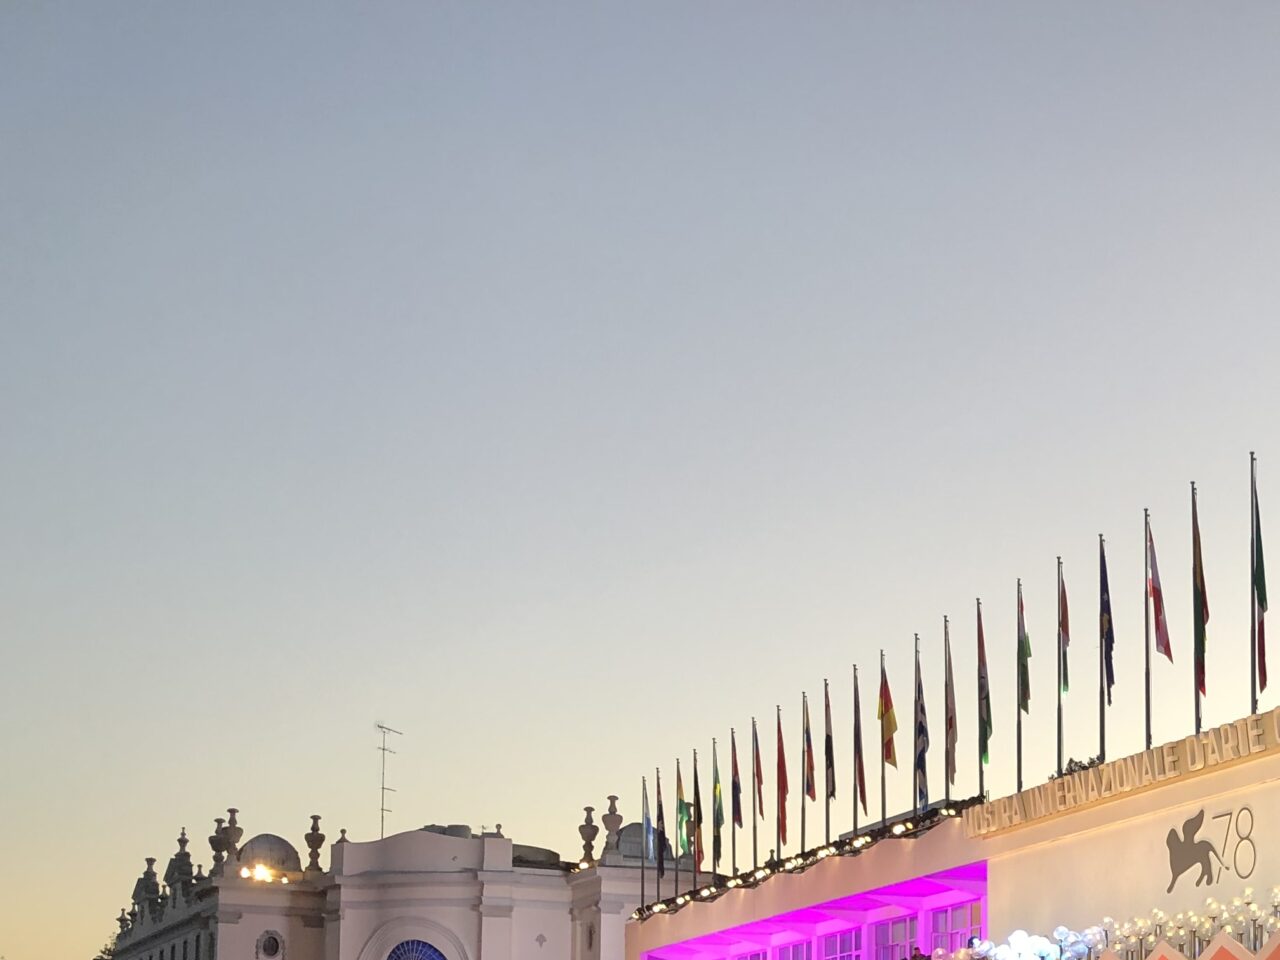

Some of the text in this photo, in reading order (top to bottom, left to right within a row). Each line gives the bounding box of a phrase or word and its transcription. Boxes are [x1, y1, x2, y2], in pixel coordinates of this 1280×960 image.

[962, 796, 1022, 838] MOSTRA
[1029, 742, 1181, 819] INTERNAZIONALE
[1185, 713, 1265, 772] D'ARTE
[1212, 806, 1256, 884] 78
